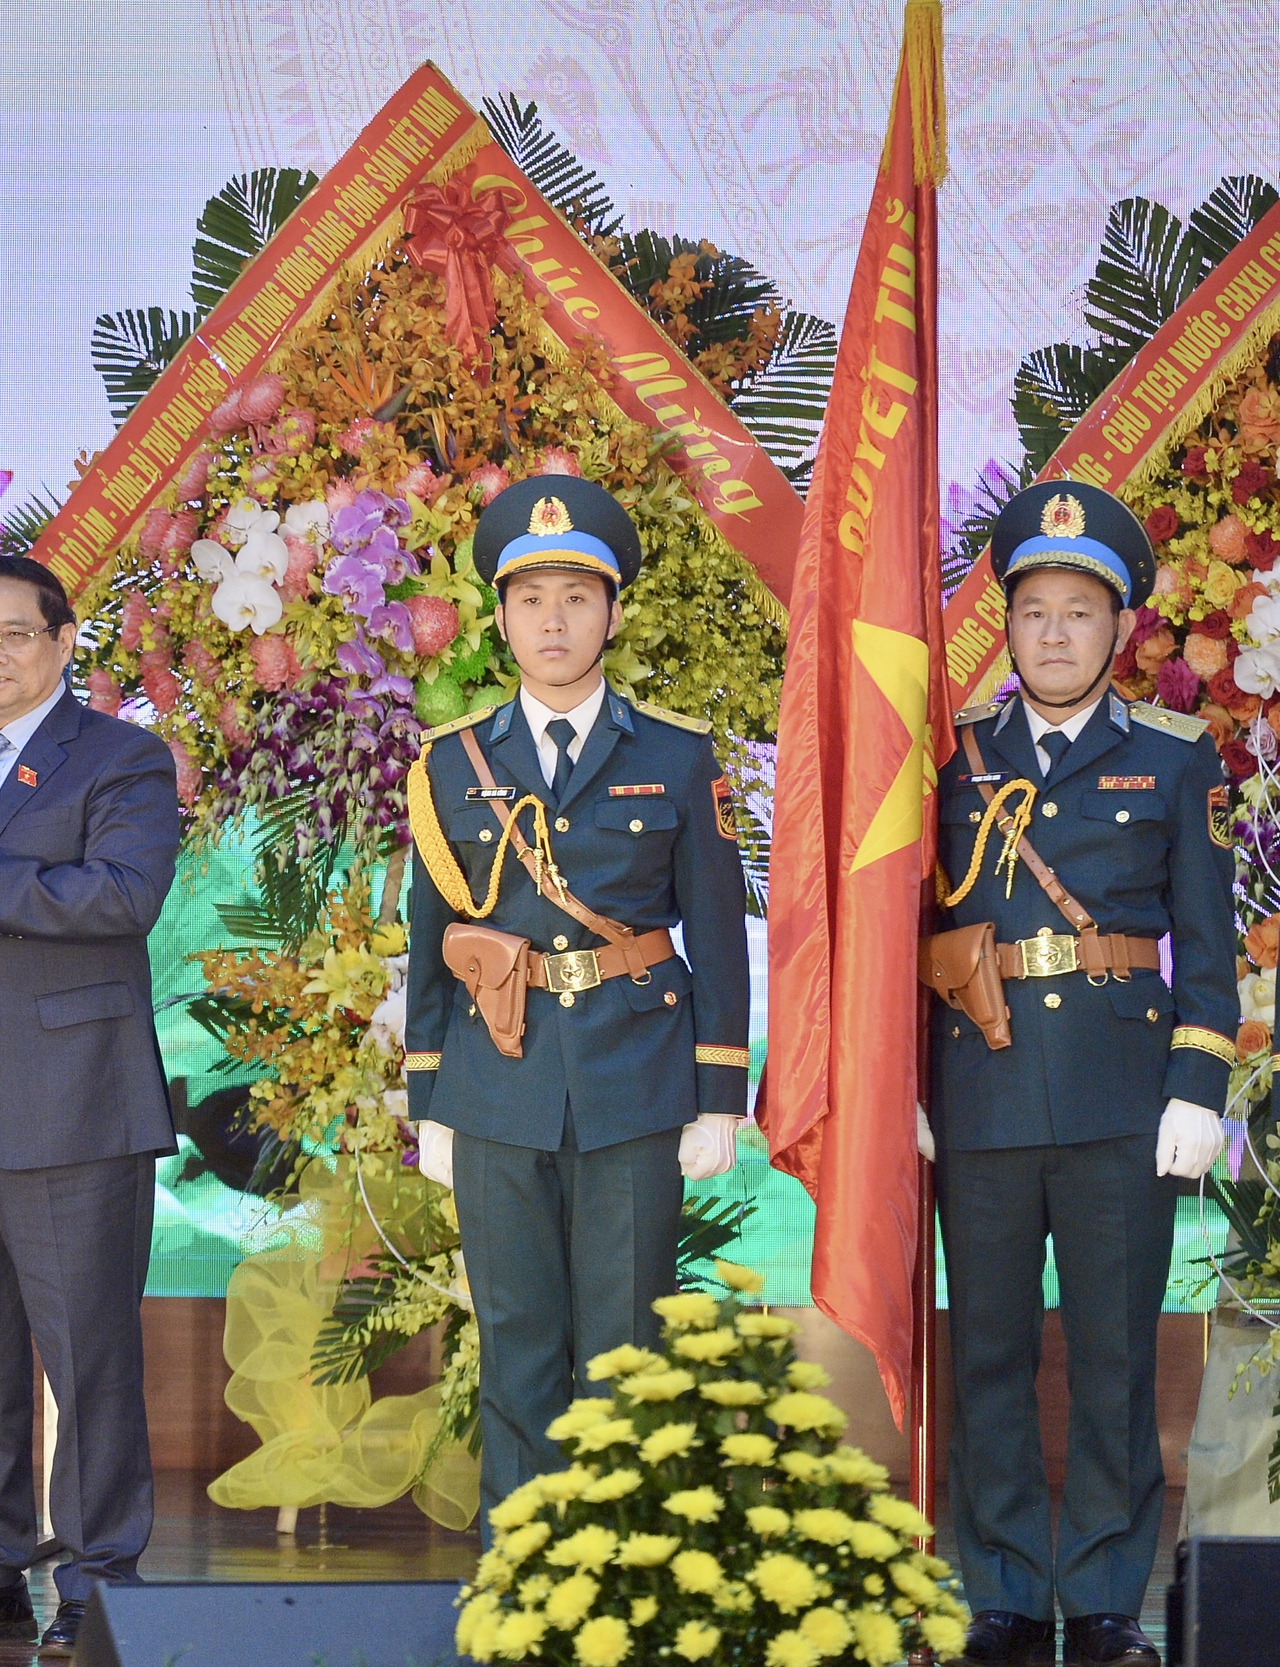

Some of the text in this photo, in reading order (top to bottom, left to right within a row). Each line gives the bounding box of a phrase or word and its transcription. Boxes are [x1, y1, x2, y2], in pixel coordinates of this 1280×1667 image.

[386, 112, 435, 165] VIỆT
[409, 87, 460, 138] NAM
[360, 146, 411, 193] SẢN
[334, 174, 387, 228] CỘNG
[301, 210, 357, 264] ĐẢNG
[275, 246, 327, 299] ƯƠNG
[239, 282, 296, 340] TRUNG
[208, 322, 262, 378] HÀNH
[471, 174, 763, 522] Chúc Mừng
[1102, 395, 1151, 454] CHỦ
[1131, 356, 1188, 413] TỊCH
[1168, 310, 1231, 373] NƯỚC
[1216, 260, 1276, 321] CHXH
[182, 354, 228, 412] CHẤP
[141, 418, 181, 465] THƯ
[161, 393, 204, 441] BAN
[129, 443, 162, 482] BÍ
[98, 465, 150, 516] TỔNG
[60, 534, 94, 571] TÔ
[73, 507, 117, 556] LÂM
[47, 547, 81, 596] HÍ
